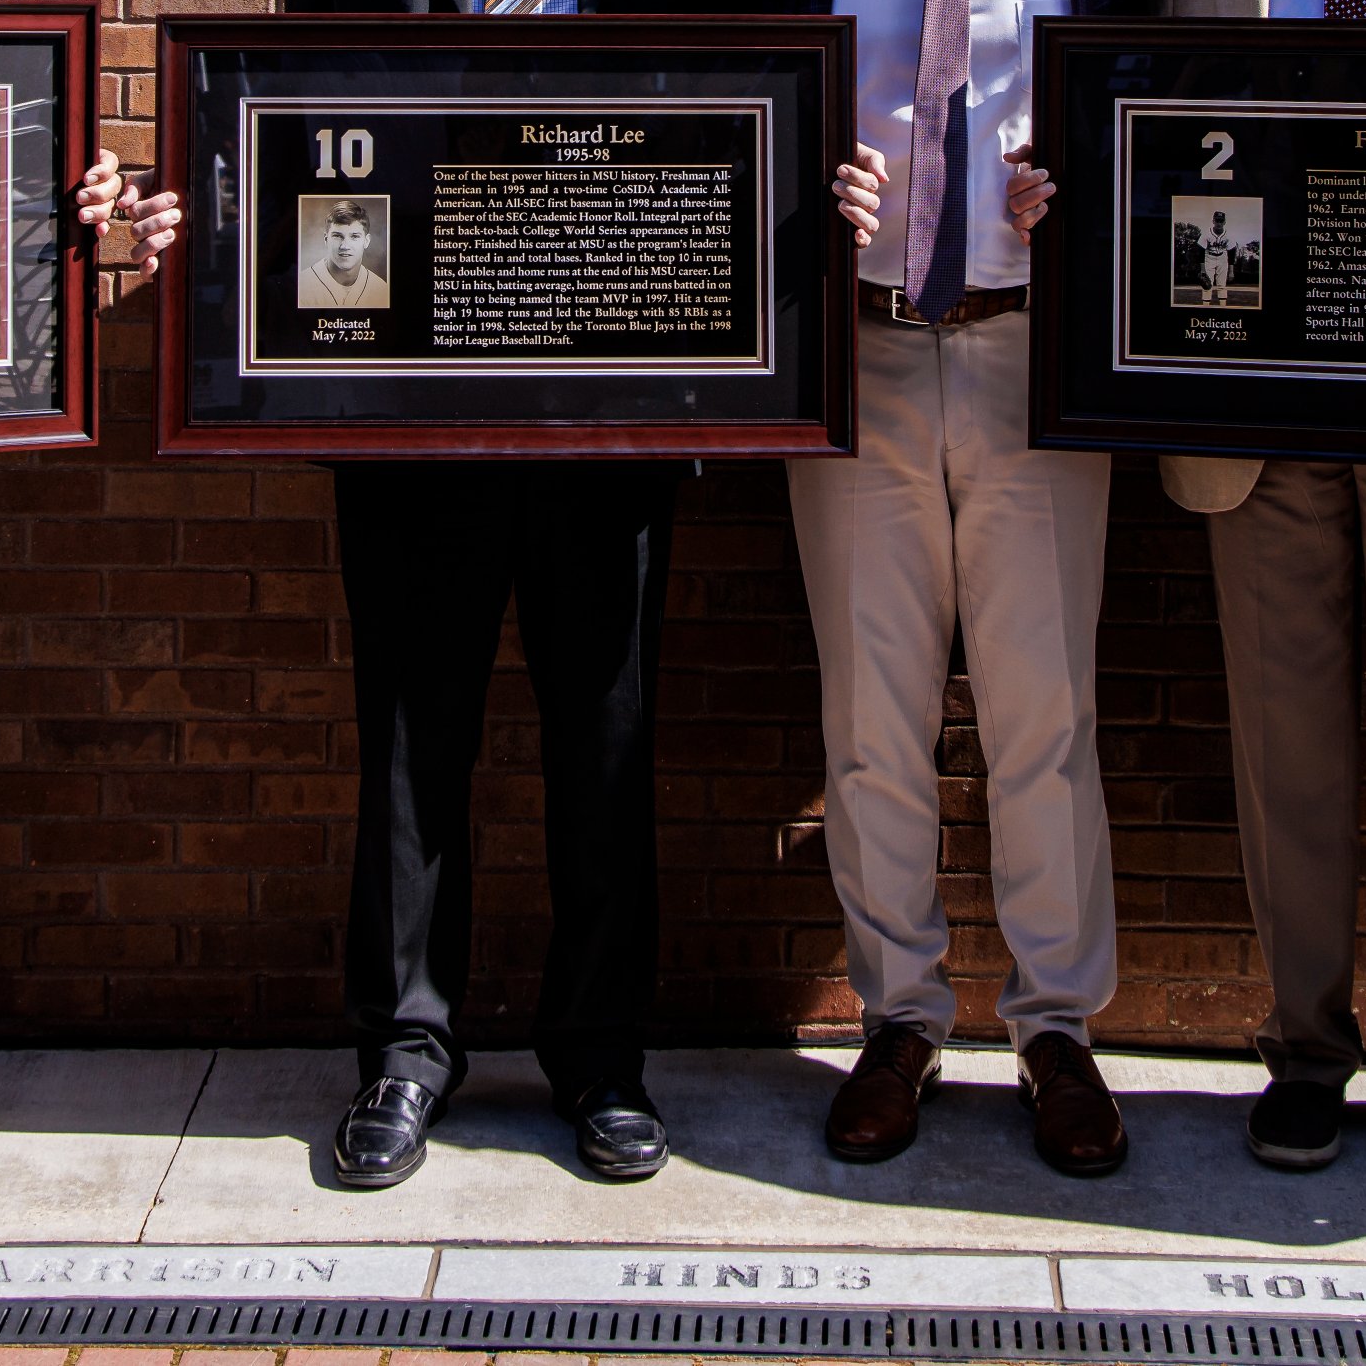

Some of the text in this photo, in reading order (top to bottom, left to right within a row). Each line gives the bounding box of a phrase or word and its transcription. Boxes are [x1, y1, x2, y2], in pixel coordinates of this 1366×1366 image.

[521, 124, 645, 144] Richard Lee
[316, 129, 373, 178] 10
[556, 148, 610, 161] 1995-98
[1201, 131, 1234, 180] 2
[433, 170, 731, 183] One of the best power hitters in MSU history. Freshman All-
[1307, 175, 1360, 186] Dominant
[434, 184, 481, 194] American
[487, 184, 497, 194] in
[503, 184, 524, 194] 1995
[529, 184, 548, 194] and
[563, 184, 607, 194] two-time
[612, 184, 655, 194] CoSIDA
[660, 184, 707, 194] Academic
[713, 184, 731, 194] All-
[1307, 189, 1317, 200] to
[1321, 192, 1334, 202] go
[318, 319, 370, 329] Dedicated
[1190, 318, 1242, 329] Dedicated
[312, 331, 375, 342] May 7, 2022
[1185, 330, 1247, 342] May 7, 2022
[617, 1262, 870, 1289] HINDS
